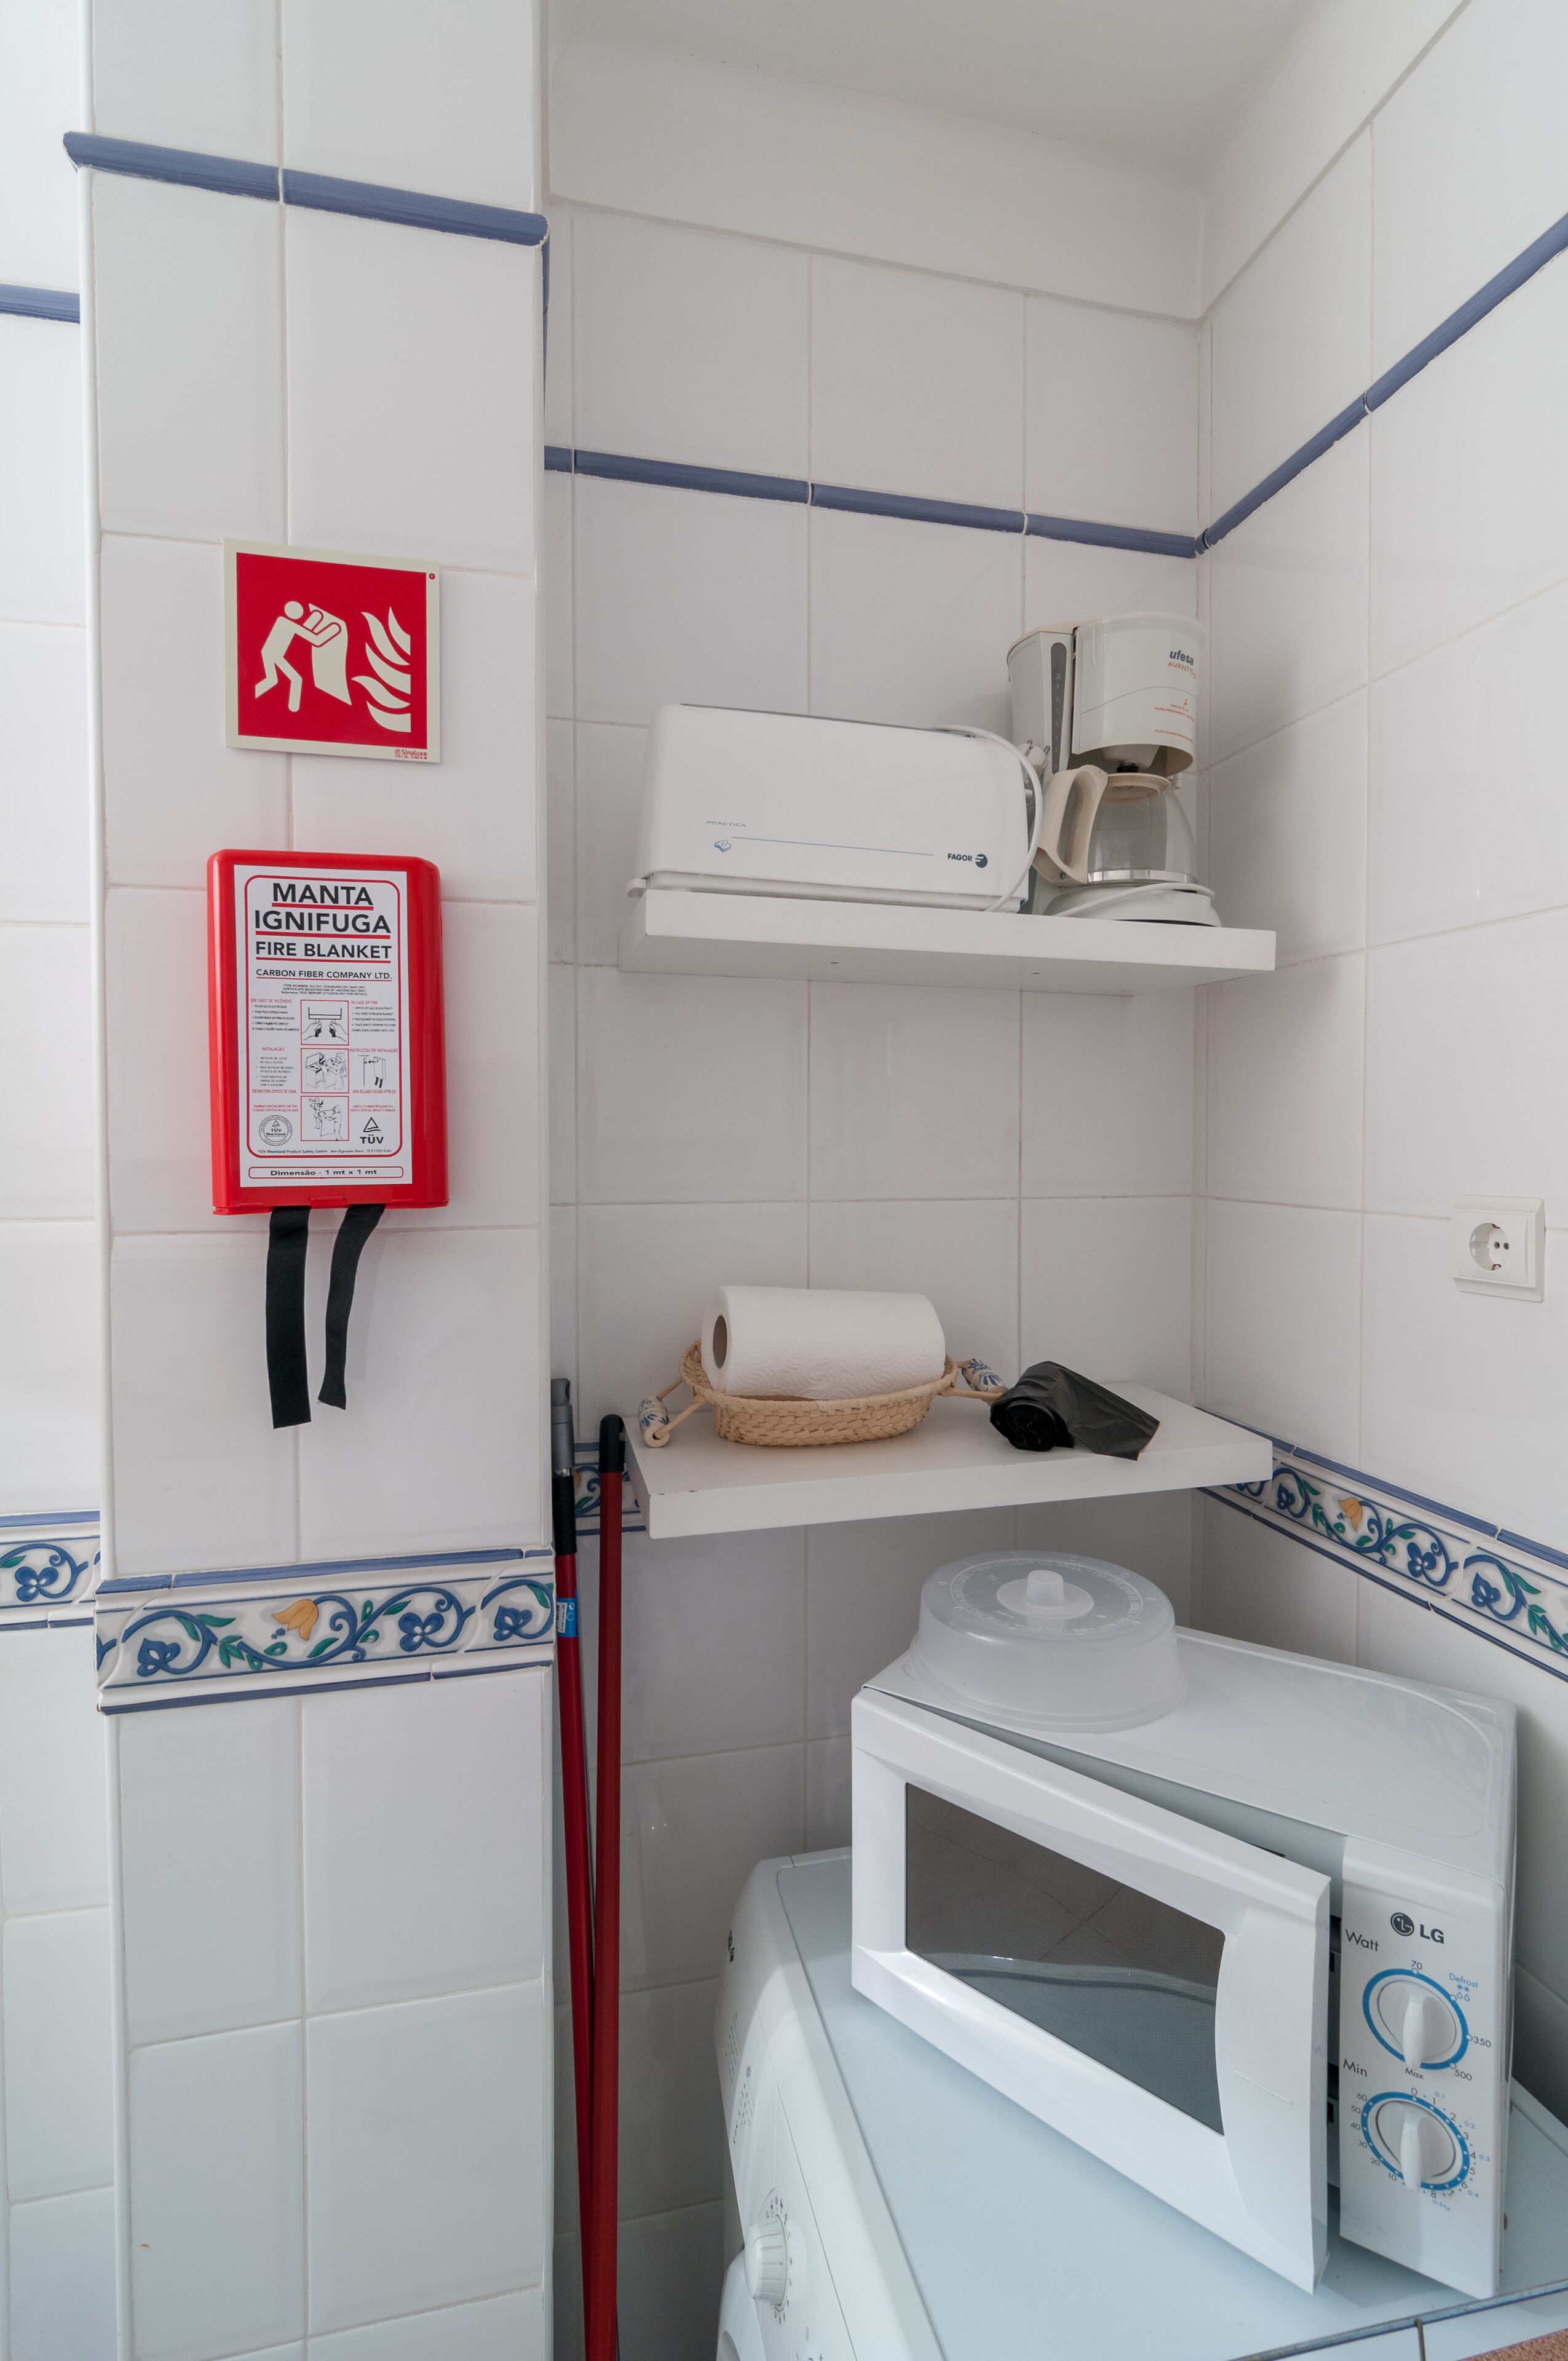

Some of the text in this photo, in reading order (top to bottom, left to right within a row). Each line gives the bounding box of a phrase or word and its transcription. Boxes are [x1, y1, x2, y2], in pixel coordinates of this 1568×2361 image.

[1169, 650, 1194, 666] ufesa
[948, 853, 972, 862] FAGOR
[273, 883, 373, 905] MANTA
[255, 910, 391, 933] IGNIFUGA
[256, 941, 392, 959] FIRE BLANKET
[256, 969, 295, 977] CARBON
[360, 1134, 384, 1144] TÜV
[1420, 1924, 1444, 1944] LG
[1345, 1929, 1379, 1952] Watt
[1411, 1960, 1423, 1970] 70
[1449, 1972, 1478, 1988] Defrost
[1473, 2036, 1491, 2048] 350
[1343, 2058, 1368, 2077] Min
[1405, 2067, 1424, 2080] Max
[1454, 2070, 1472, 2081] 500
[1357, 2093, 1368, 2102] 60
[1432, 2097, 1436, 2105] 1
[1350, 2105, 1361, 2114] 50
[1450, 2113, 1456, 2121] 2
[1350, 2122, 1361, 2131] 40
[1464, 2121, 1475, 2129] 0.2
[1463, 2132, 1469, 2140] 3
[1358, 2140, 1368, 2149] 30
[1370, 2157, 1380, 2166] 20
[1479, 2154, 1490, 2162] 0.3
[1469, 2167, 1476, 2175] 5
[1388, 2172, 1397, 2181] 10
[1430, 2191, 1437, 2199] 8
[1468, 2190, 1479, 2198] 0.4
